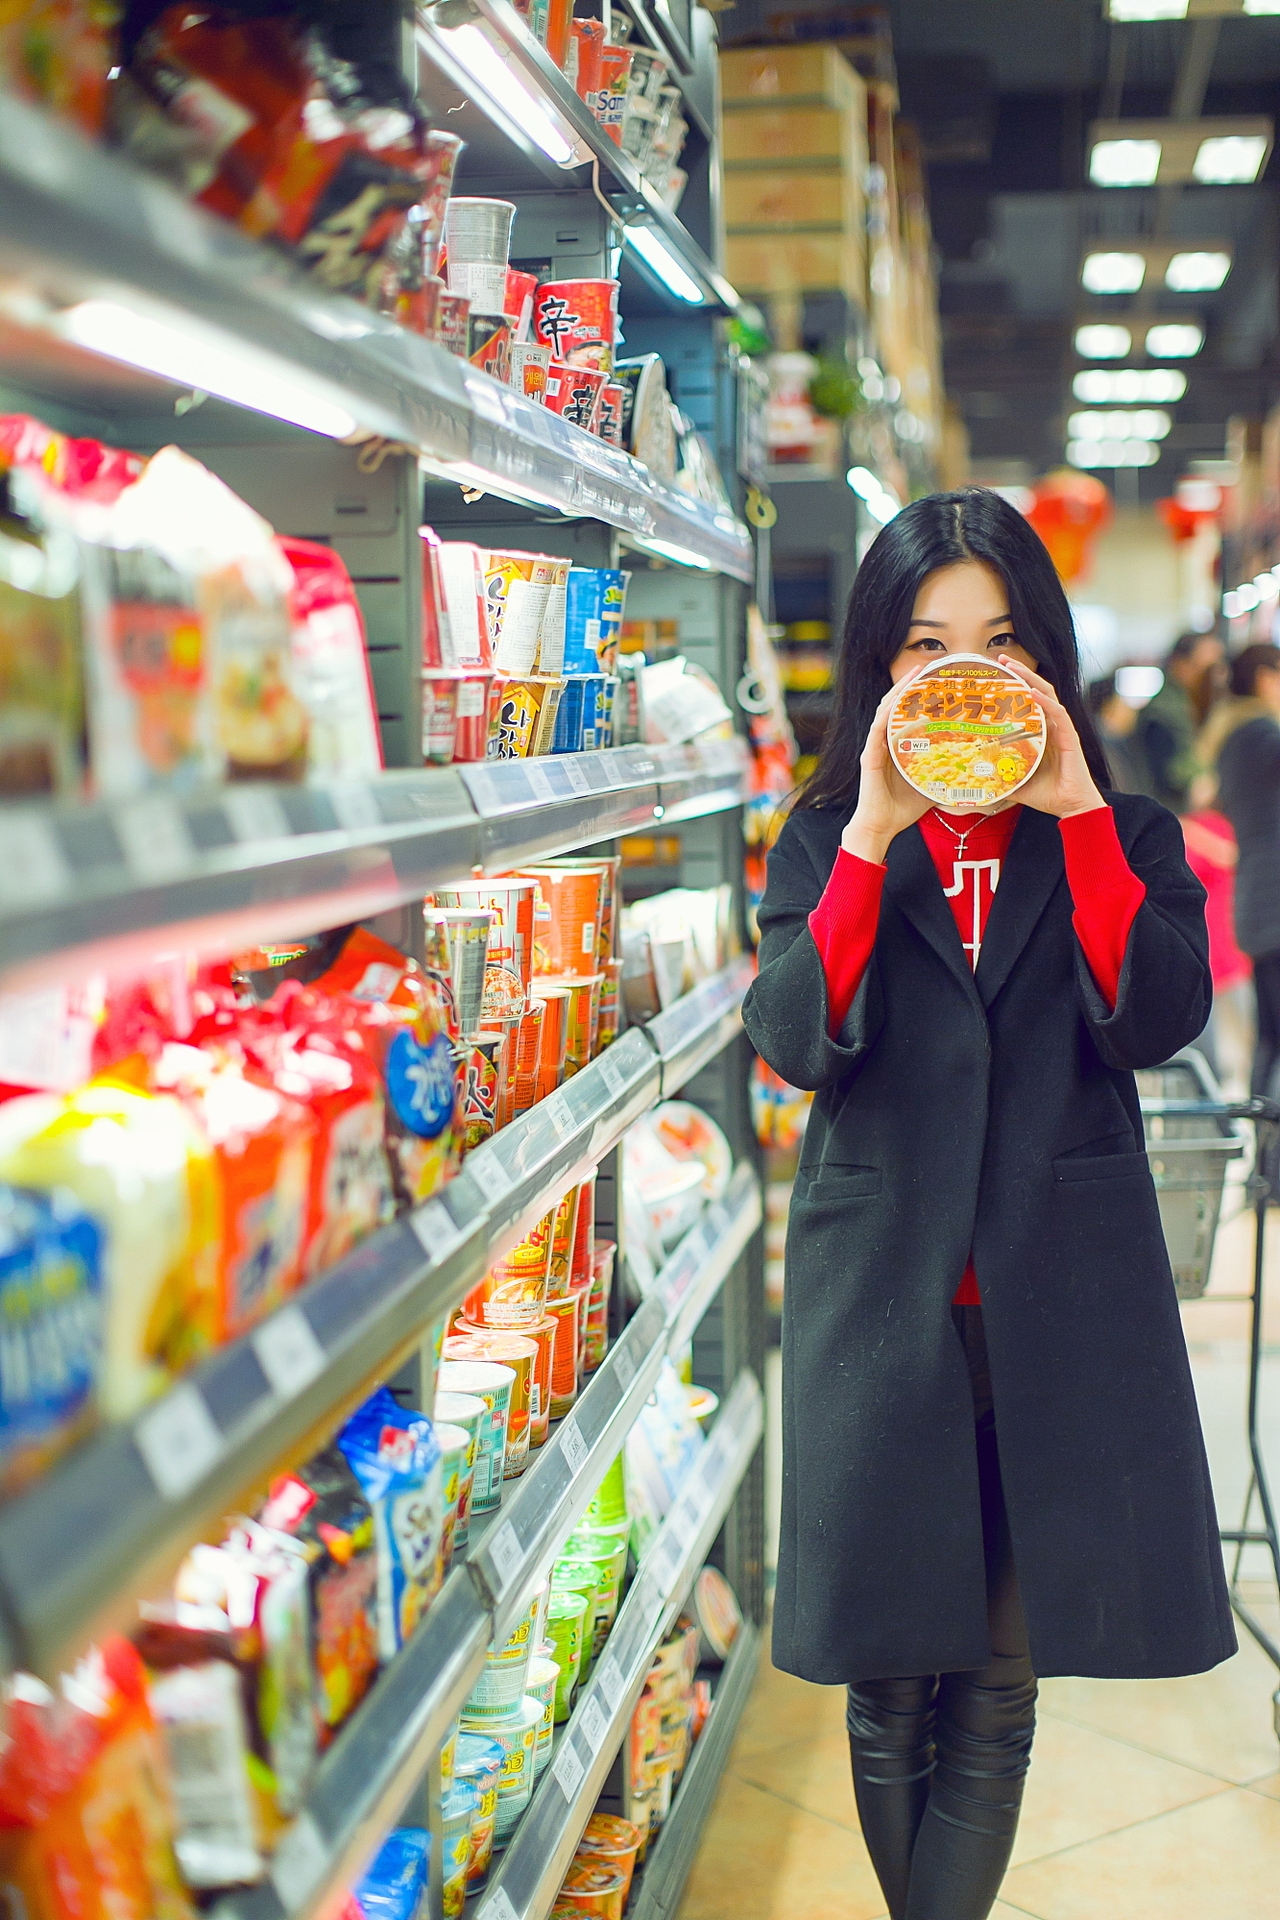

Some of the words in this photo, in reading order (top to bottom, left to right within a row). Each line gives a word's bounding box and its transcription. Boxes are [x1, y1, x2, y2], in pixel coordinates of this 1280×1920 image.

[540, 297, 579, 357] 辛
[901, 692, 1034, 720] チキンラーメン
